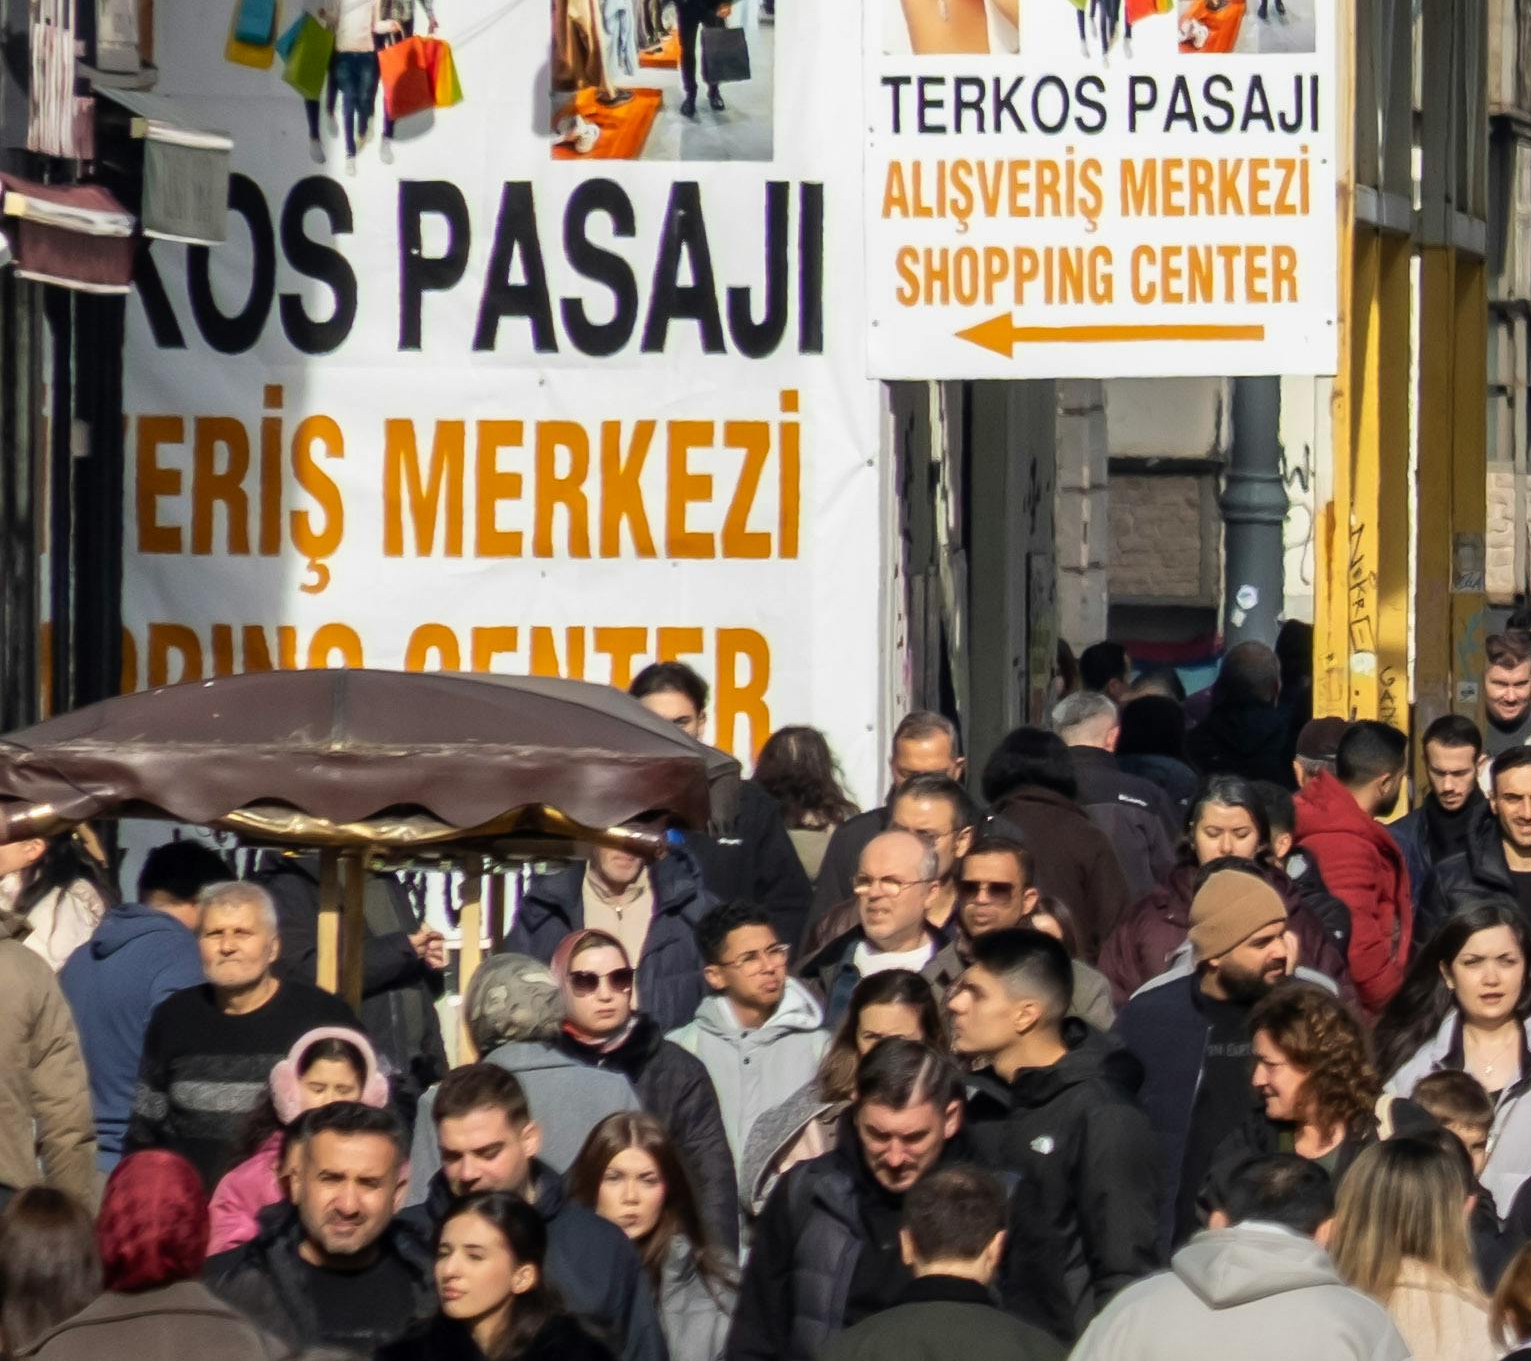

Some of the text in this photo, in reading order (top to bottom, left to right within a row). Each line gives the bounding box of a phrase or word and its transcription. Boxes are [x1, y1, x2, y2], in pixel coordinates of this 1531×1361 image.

[880, 73, 1320, 134] TERKOS PASAJI
[881, 143, 1310, 234] ALIŞVERİŞ MERKEZİ
[397, 176, 825, 359] PASAJI
[895, 244, 1299, 307] SHOPPING CENTER
[123, 383, 801, 595] ERİŞ MERKEZİ
